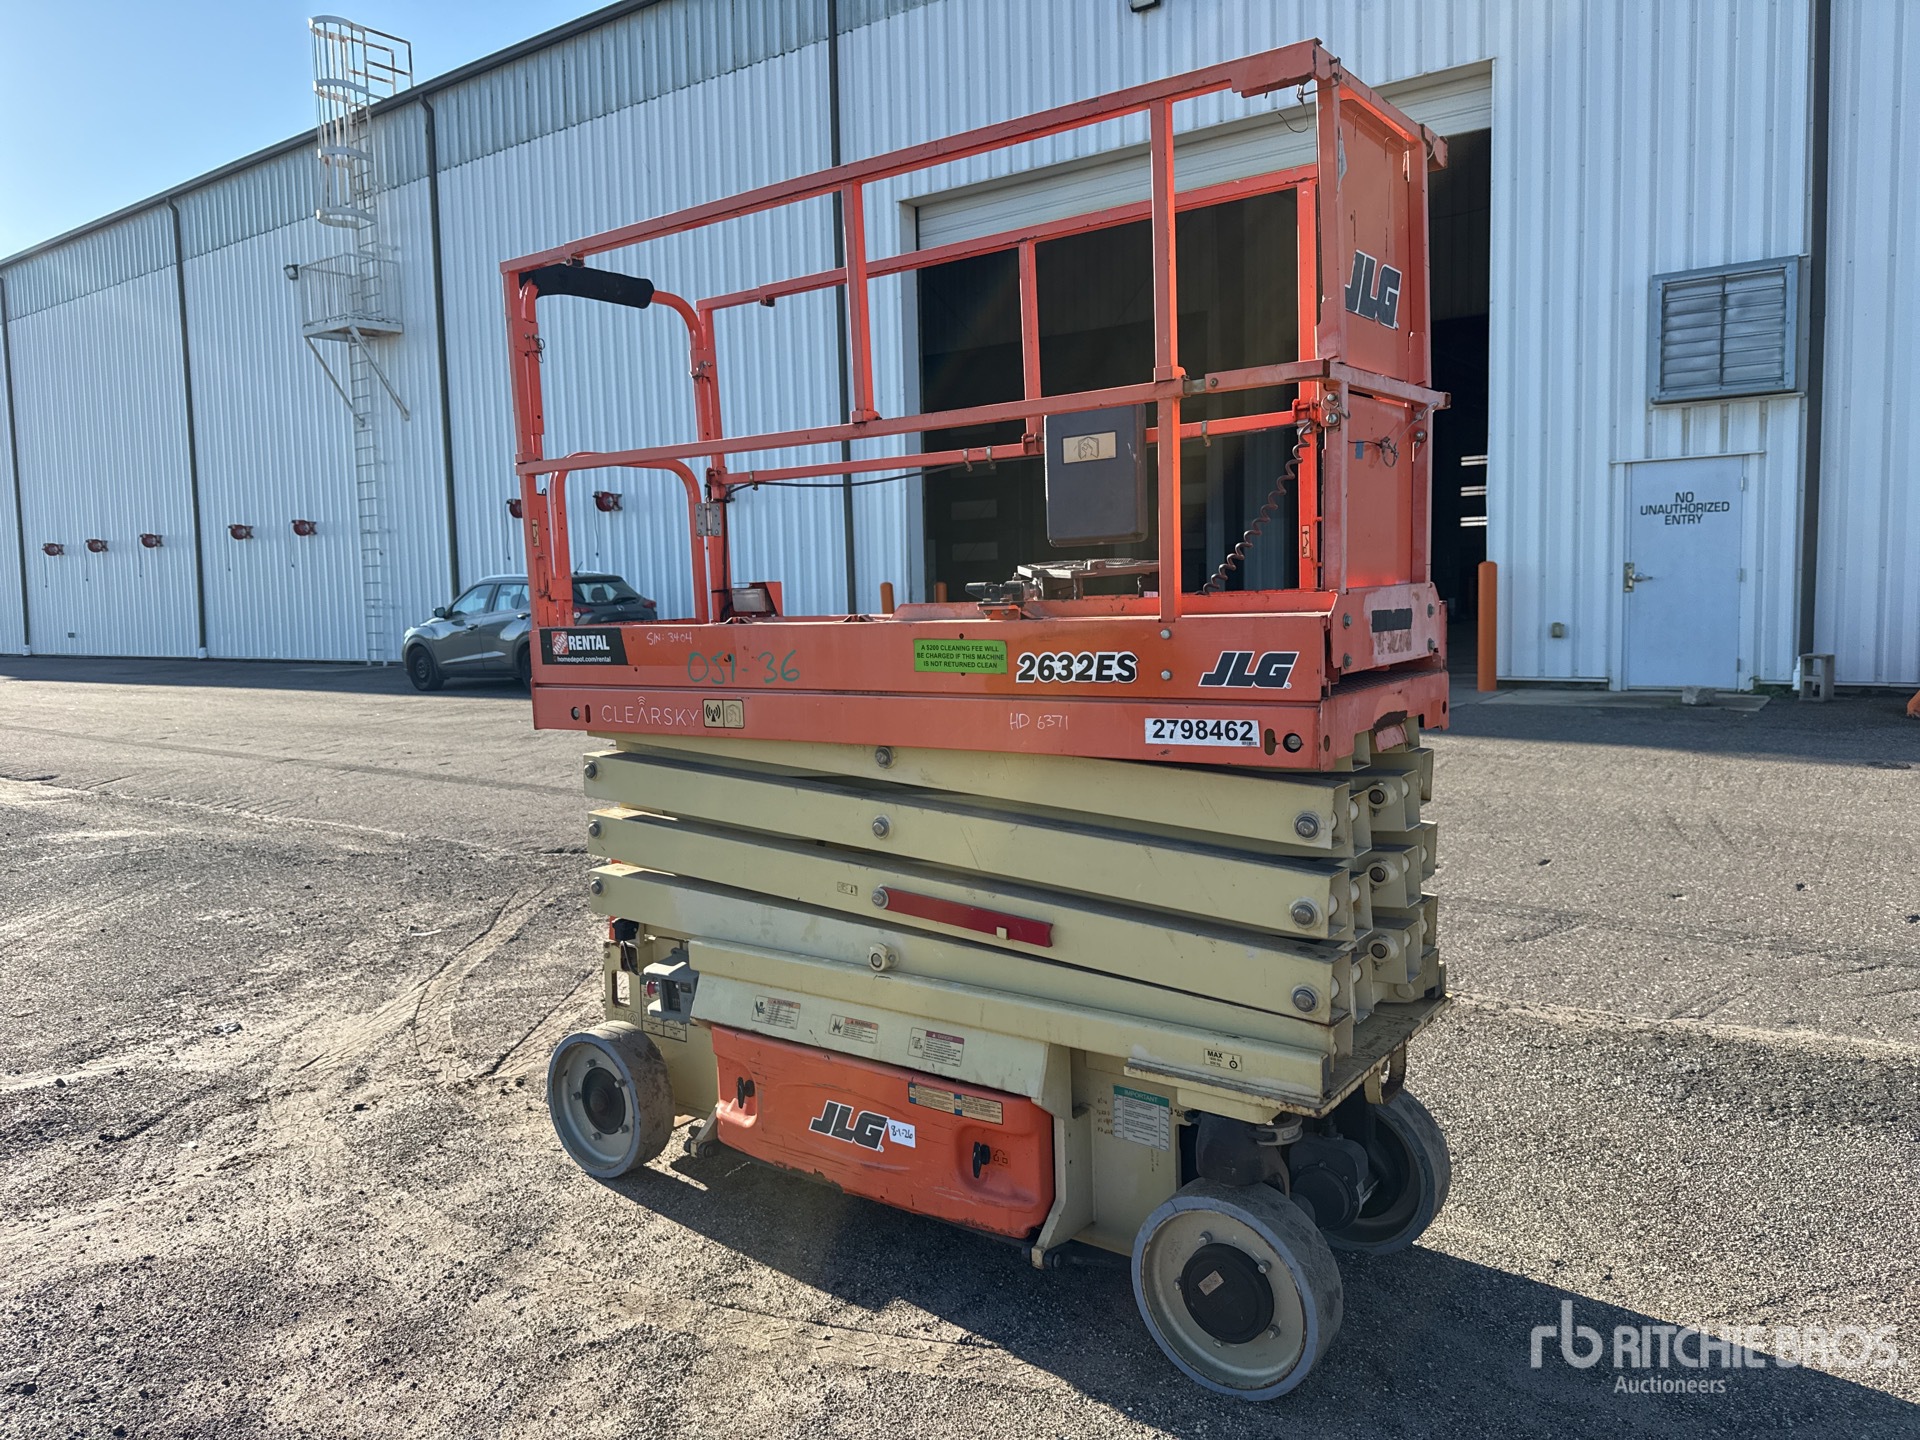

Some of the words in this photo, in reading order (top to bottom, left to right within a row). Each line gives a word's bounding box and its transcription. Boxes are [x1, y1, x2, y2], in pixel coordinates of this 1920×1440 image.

[1345, 250, 1401, 329] JLG
[1675, 491, 1694, 503] NO
[1640, 501, 1730, 516] UNAUTHORIZED
[1664, 513, 1703, 525] ENTRY
[568, 635, 610, 650] RENTAL
[668, 632, 693, 644] 3404
[557, 655, 611, 663] homedepot.com/rental
[1016, 651, 1138, 683] 2632ES
[1198, 651, 1299, 688] JLG
[601, 704, 699, 727] CLEARSKY
[1009, 712, 1030, 729] HD
[1037, 714, 1069, 731] 6371
[1152, 719, 1254, 742] 2798462
[1207, 1050, 1223, 1058] MAX
[1124, 1089, 1158, 1103] IMPORTANT
[809, 1100, 889, 1151] JLG
